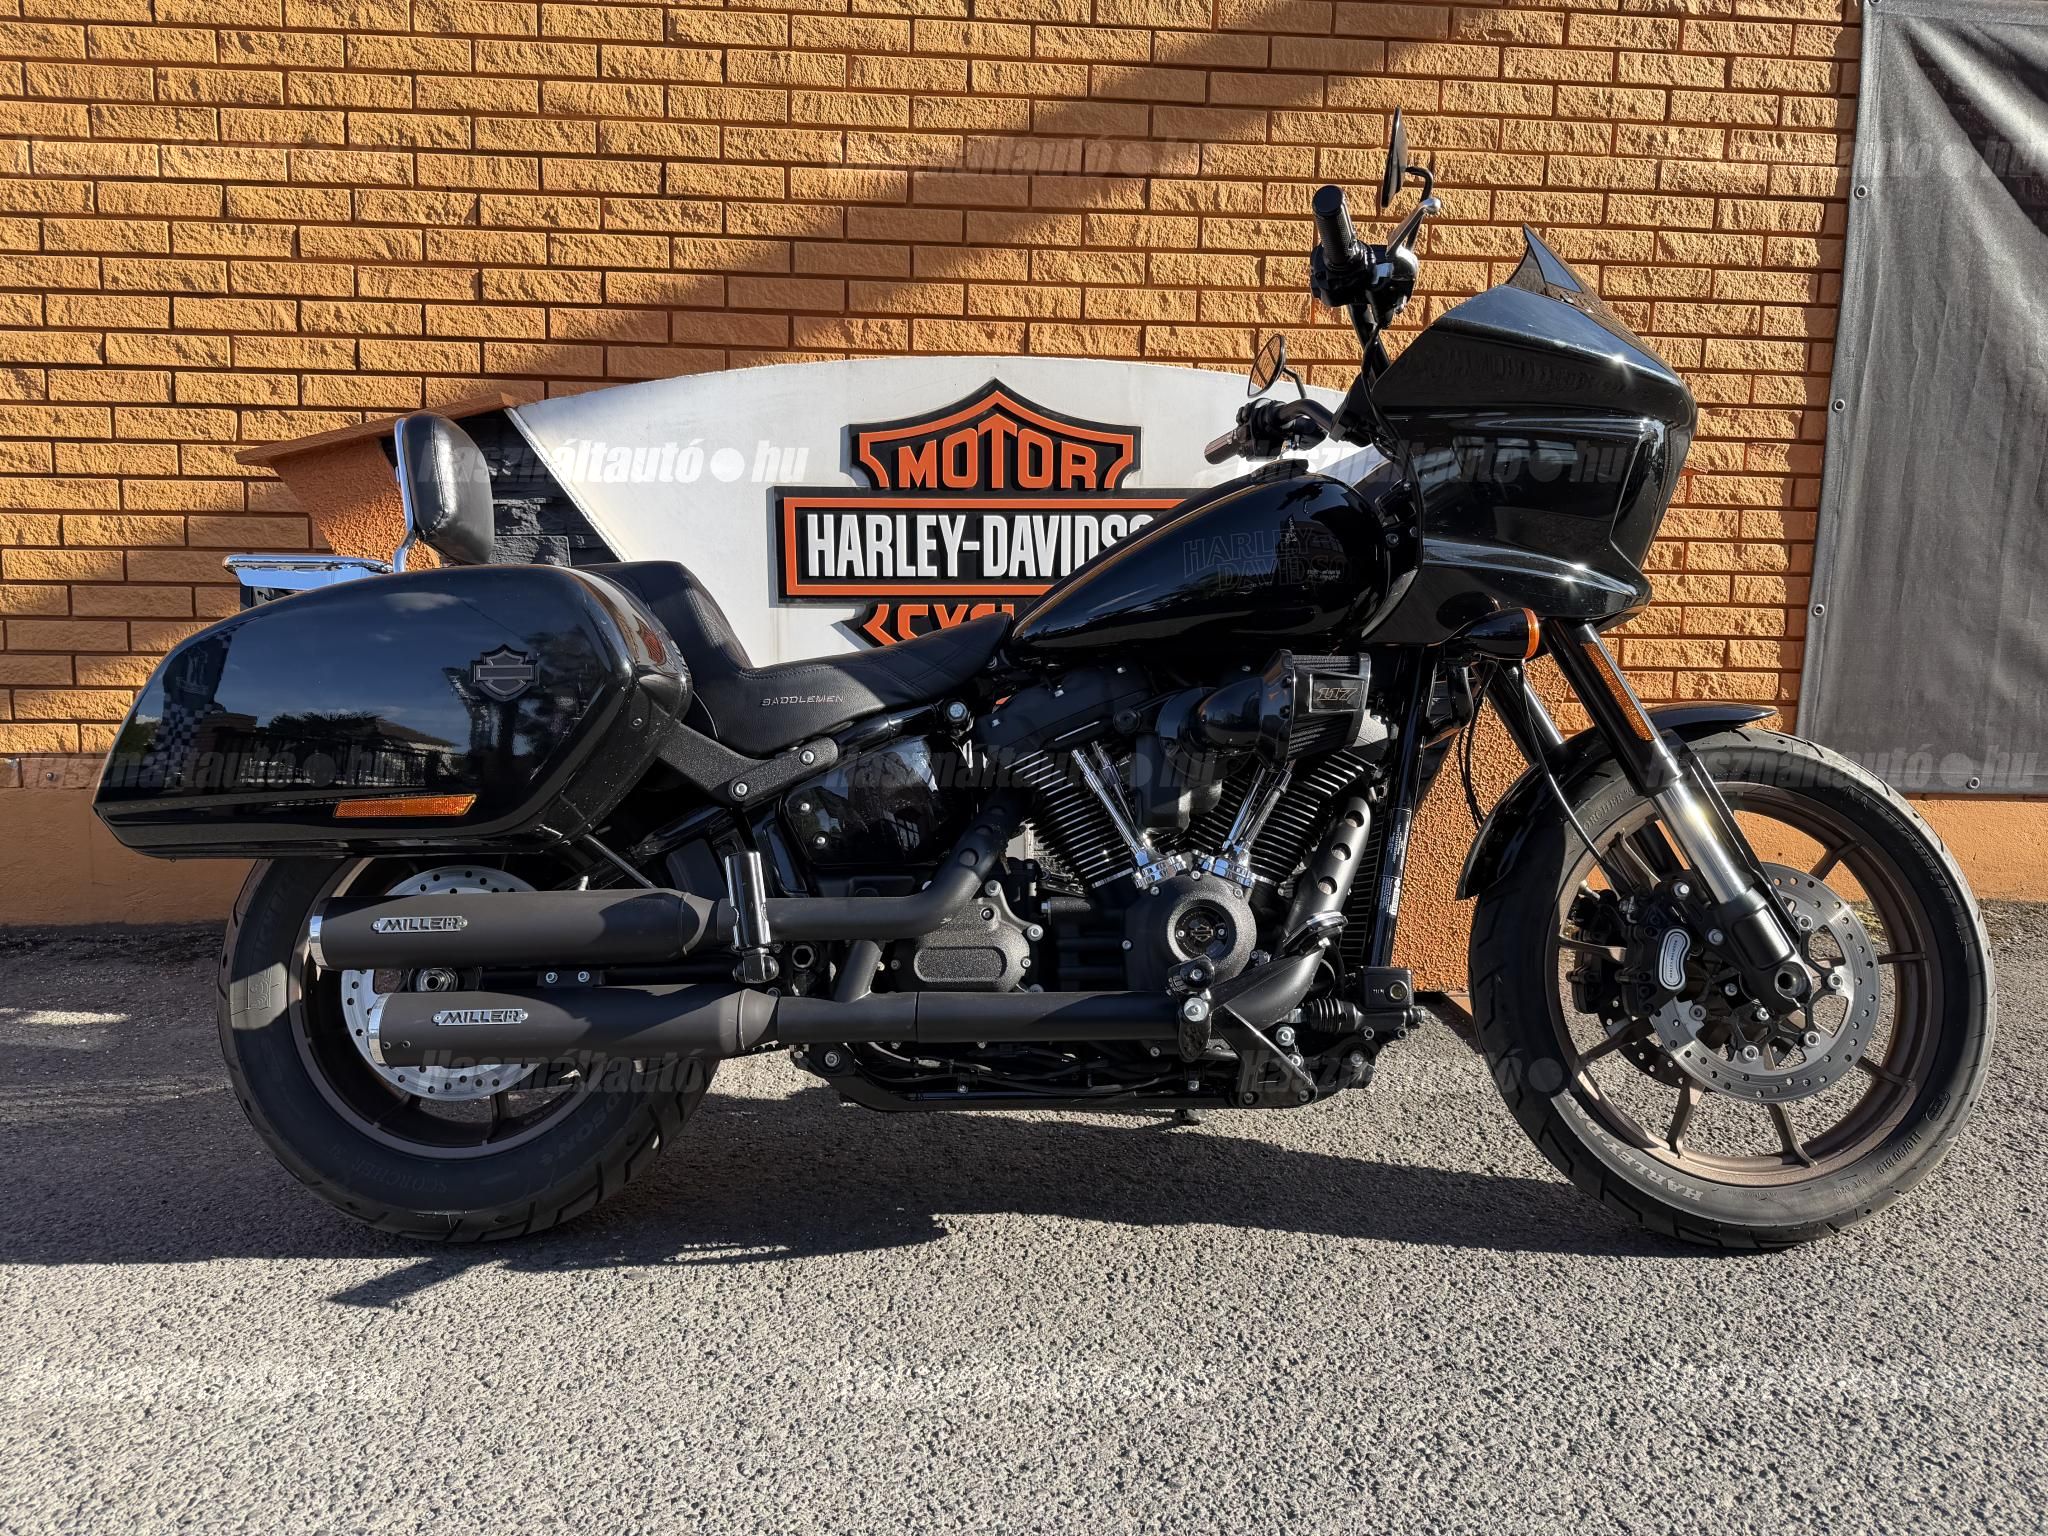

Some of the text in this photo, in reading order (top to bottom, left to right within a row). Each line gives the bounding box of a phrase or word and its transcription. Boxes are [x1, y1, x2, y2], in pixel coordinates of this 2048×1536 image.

[898, 413, 1097, 489] MOTOR
[761, 694, 844, 707] SADDLEMEN
[1315, 686, 1359, 701] 117
[382, 917, 459, 932] MILLER
[442, 1009, 519, 1024] MILLER
